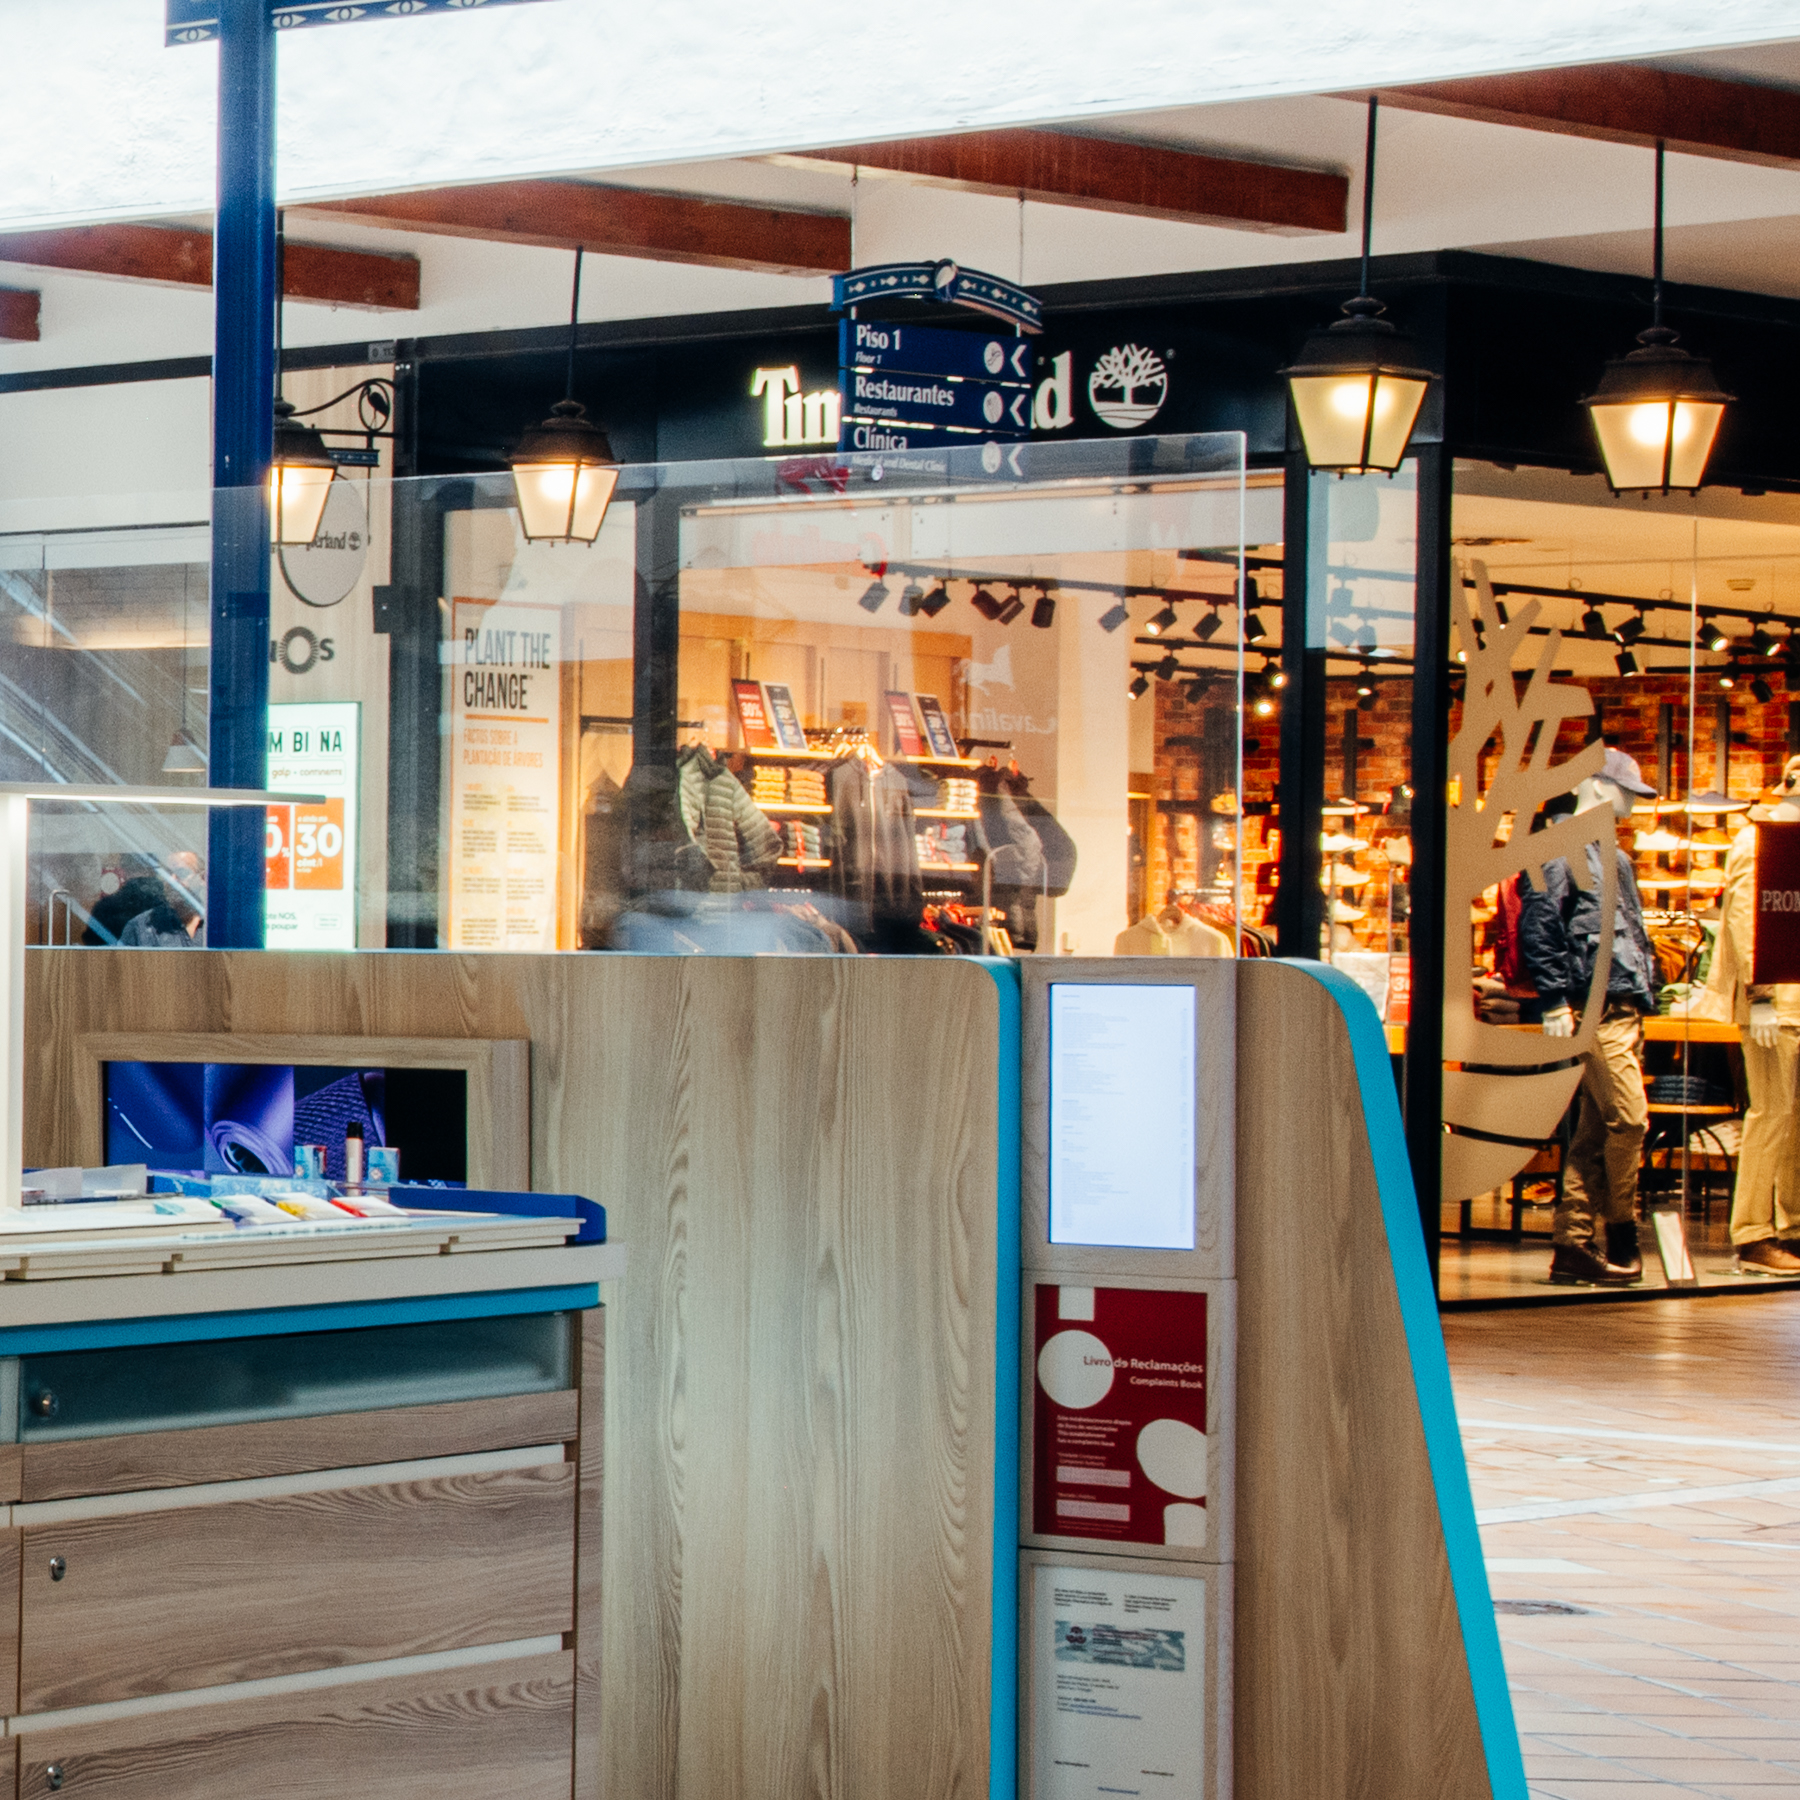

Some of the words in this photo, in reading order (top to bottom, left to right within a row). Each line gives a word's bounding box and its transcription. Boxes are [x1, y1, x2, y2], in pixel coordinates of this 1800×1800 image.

[856, 324, 889, 349] Piso
[893, 329, 901, 350] 1
[855, 351, 876, 364] Floor
[876, 354, 882, 364] 1
[855, 376, 955, 407] Restaurantes
[854, 403, 898, 417] Restaurants
[853, 426, 907, 451] Clínica
[464, 628, 516, 668] PLANT
[521, 632, 551, 669] THE
[490, 729, 511, 746] SOBRE
[503, 750, 512, 766] DE
[296, 824, 342, 858] 30
[1084, 1356, 1111, 1367] Livro
[1114, 1357, 1129, 1368] de
[1130, 1358, 1204, 1374] Reclamações
[1129, 1376, 1179, 1389] Complaints
[1180, 1380, 1203, 1389] Book
